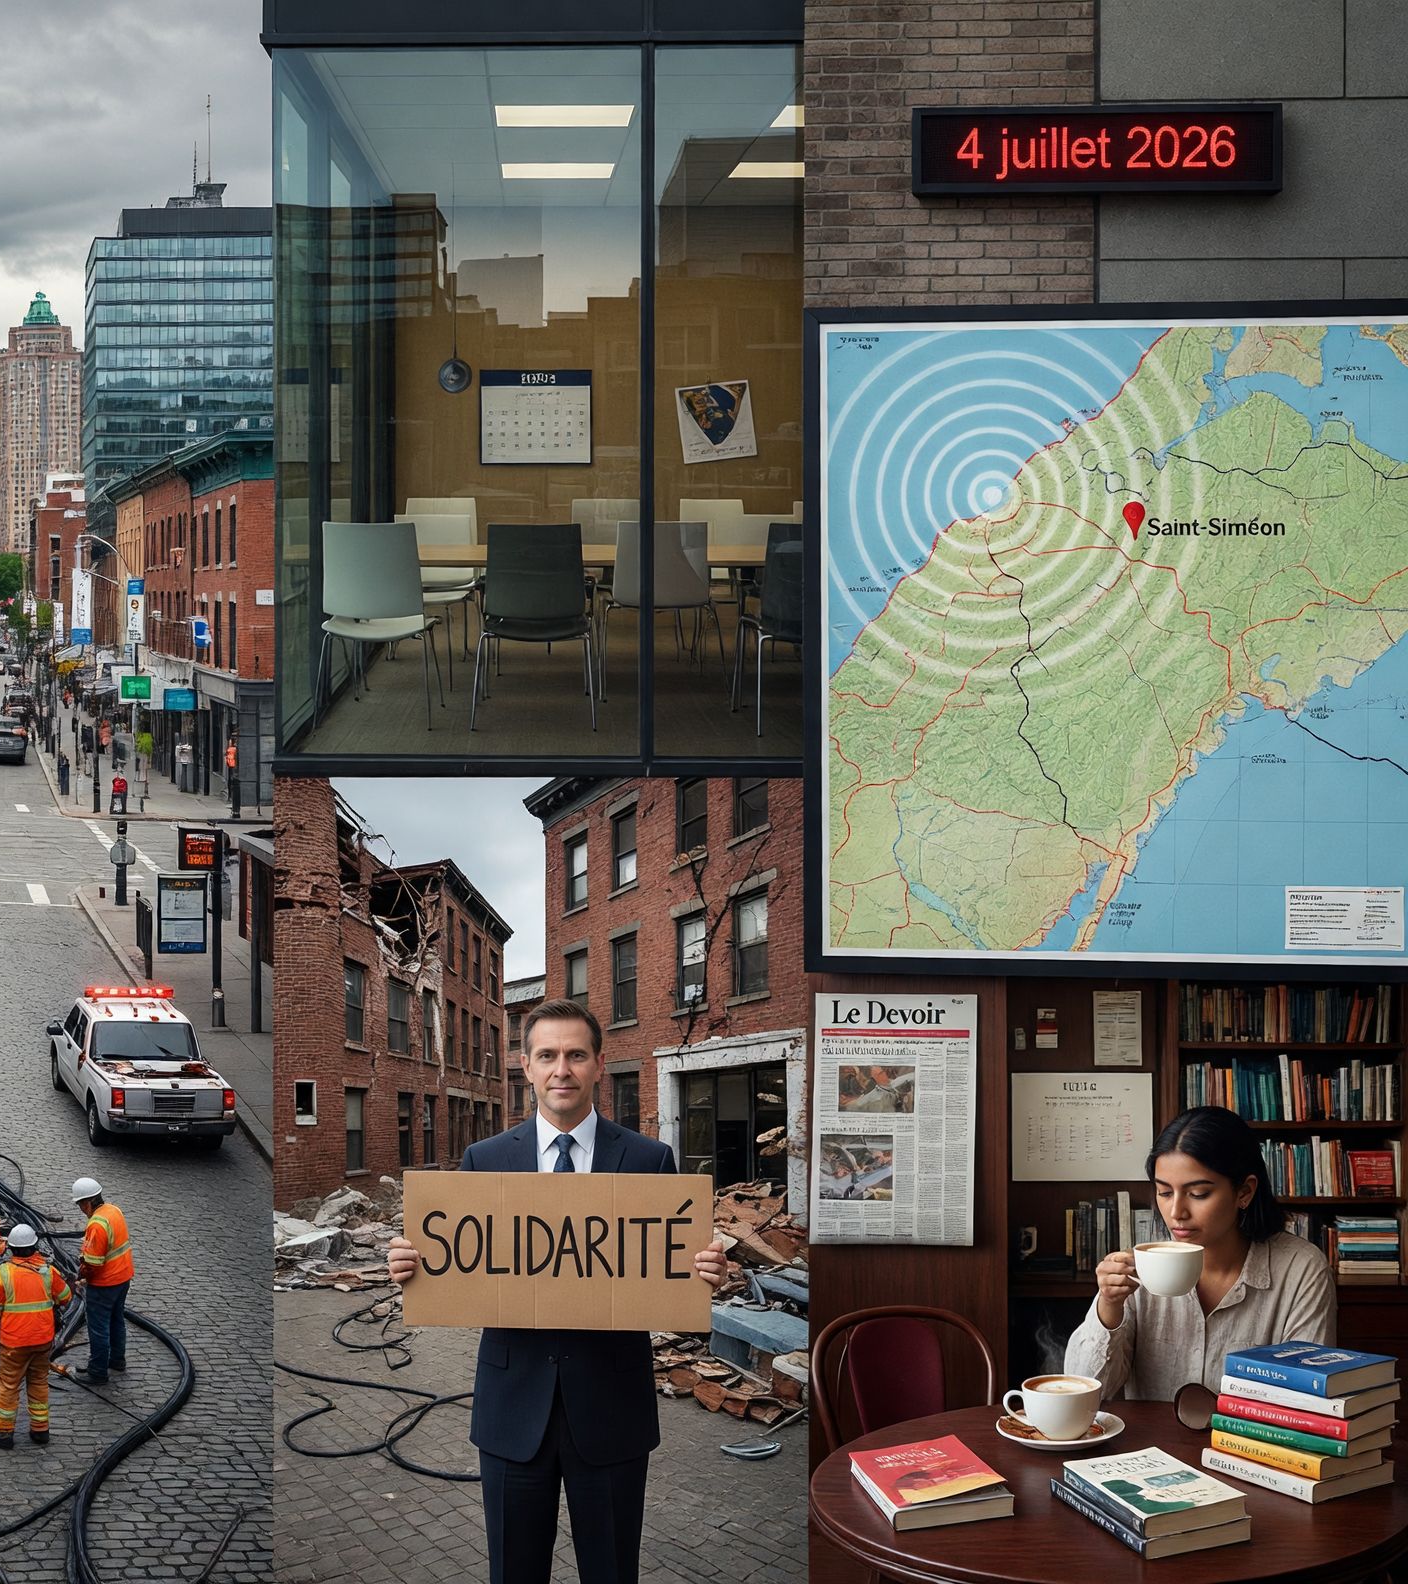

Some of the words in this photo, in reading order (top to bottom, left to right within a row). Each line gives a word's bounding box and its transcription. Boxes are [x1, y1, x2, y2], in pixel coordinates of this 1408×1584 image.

[956, 127, 984, 169] 4
[995, 126, 1112, 180] juillet
[1126, 125, 1236, 169] 2026
[1147, 513, 1286, 537] Saint-Siméon
[831, 999, 861, 1024] Le
[866, 1000, 946, 1025] Devoir
[421, 1198, 694, 1280] SOLIDARITÉ
